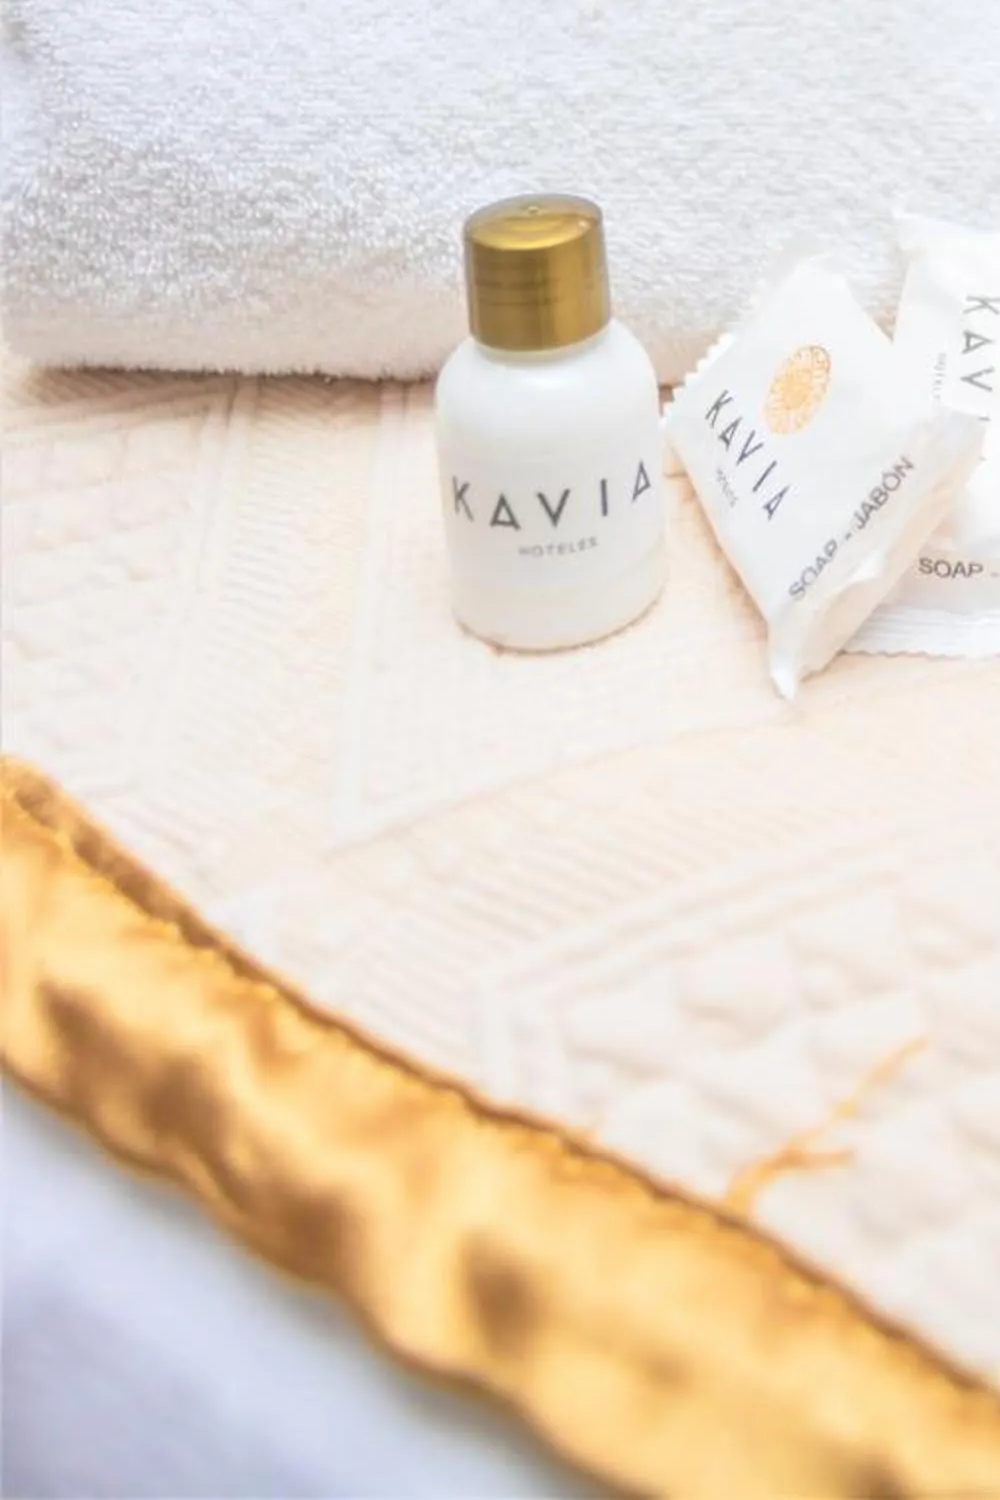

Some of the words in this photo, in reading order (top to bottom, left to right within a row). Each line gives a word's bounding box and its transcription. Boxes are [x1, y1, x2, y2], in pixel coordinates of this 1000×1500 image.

[452, 460, 651, 531] KAVIA
[705, 388, 790, 521] KAVIA
[788, 537, 839, 601] SOAP
[853, 455, 915, 530] JABÓN
[918, 556, 984, 579] SOAP
